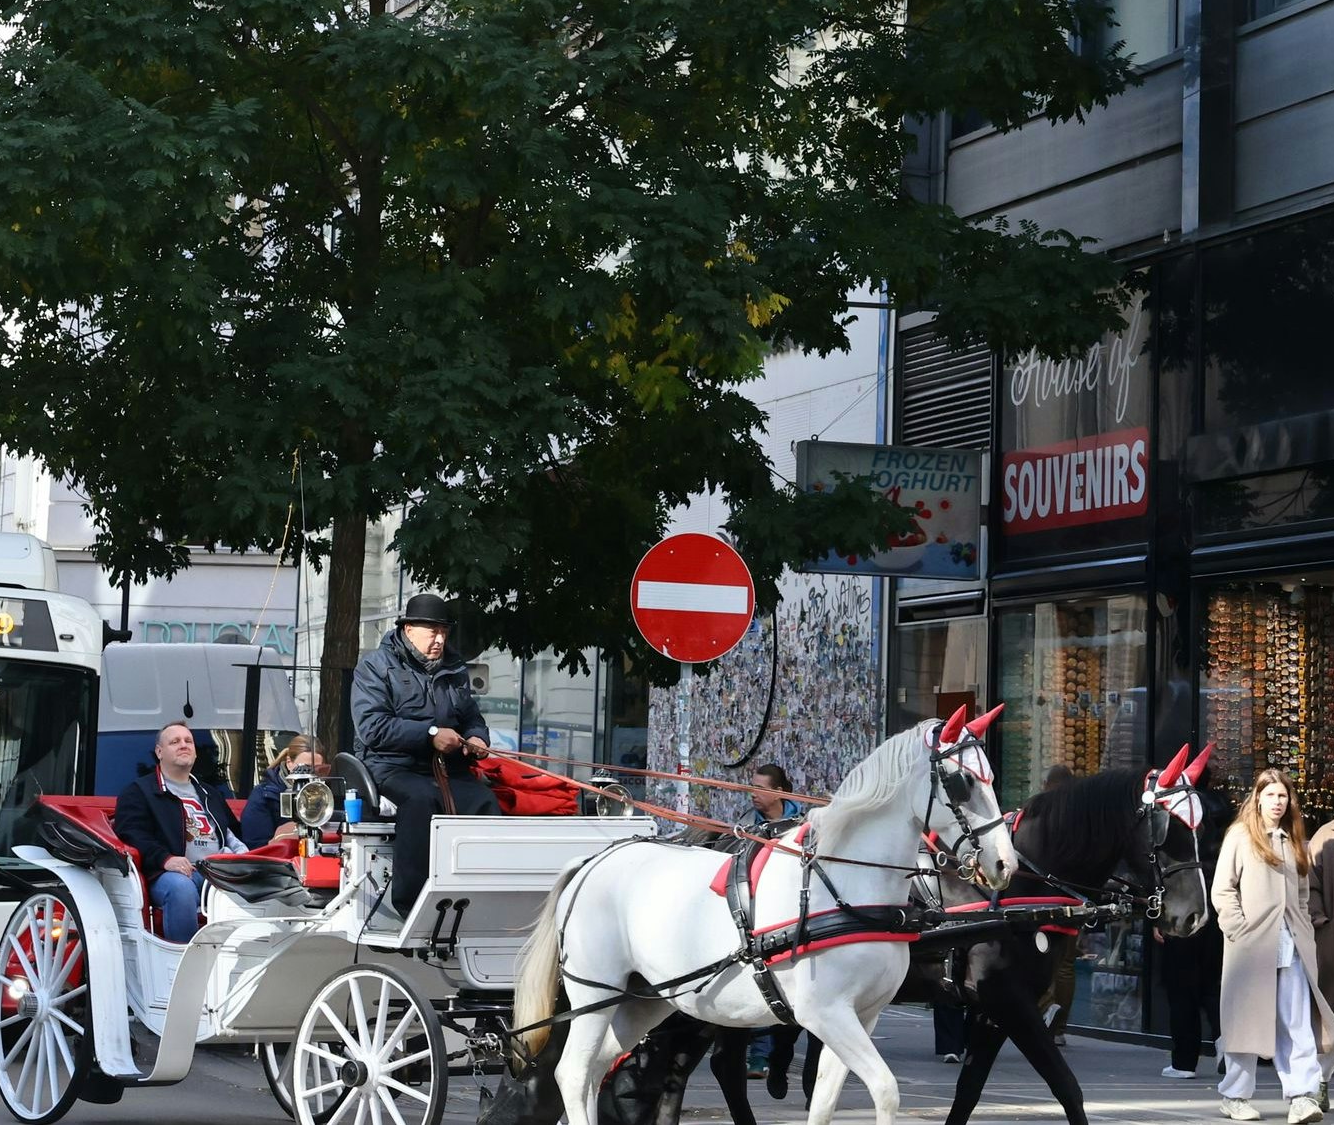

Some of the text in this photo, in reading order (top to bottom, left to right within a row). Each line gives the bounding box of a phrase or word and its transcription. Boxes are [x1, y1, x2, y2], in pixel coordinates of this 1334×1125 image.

[1011, 297, 1144, 424] House of
[871, 451, 968, 473] FROZEN
[1003, 439, 1146, 523] SOUVENIRS
